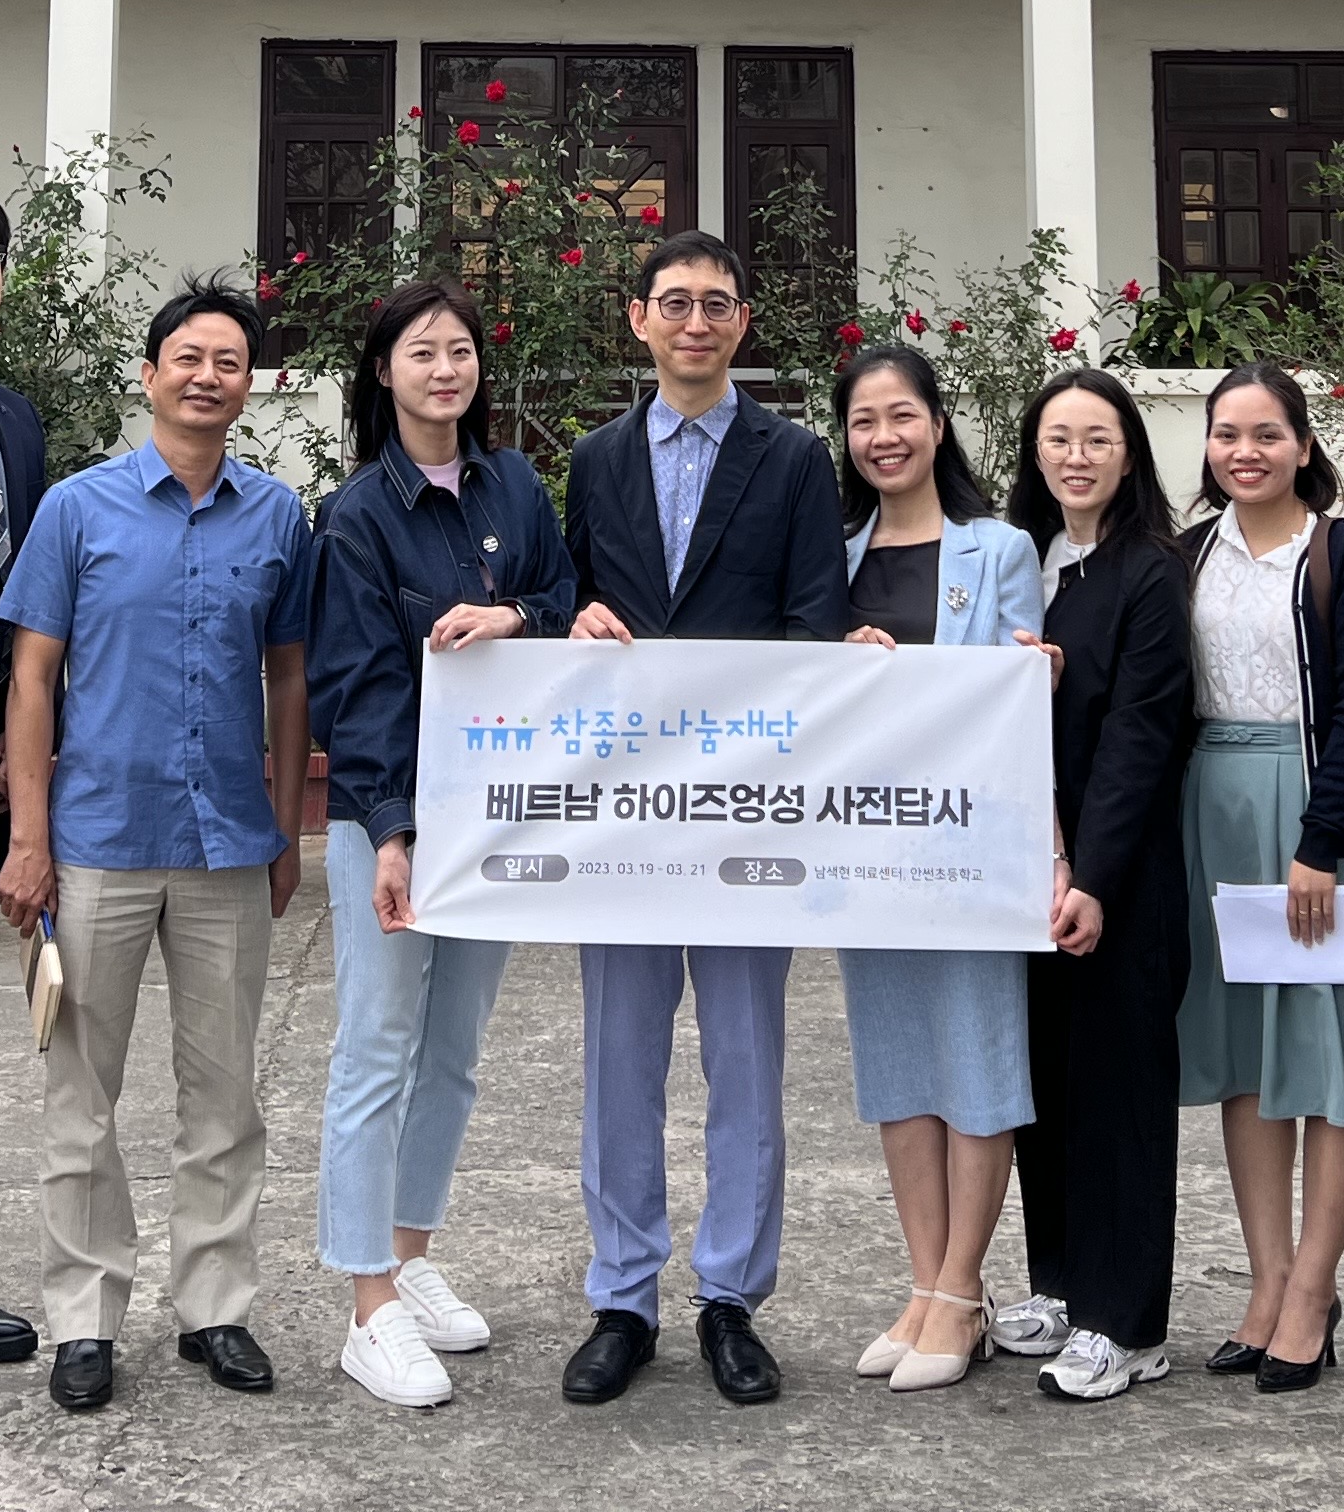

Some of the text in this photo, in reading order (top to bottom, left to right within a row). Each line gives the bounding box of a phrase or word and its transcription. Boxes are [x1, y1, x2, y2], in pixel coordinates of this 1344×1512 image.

[550, 708, 799, 759] 참좋은 나눔재단
[485, 782, 974, 829] 베트남 하이즈엉성 사전답사
[504, 857, 544, 880] 일시
[690, 864, 706, 877] 21
[743, 861, 785, 884] 장소
